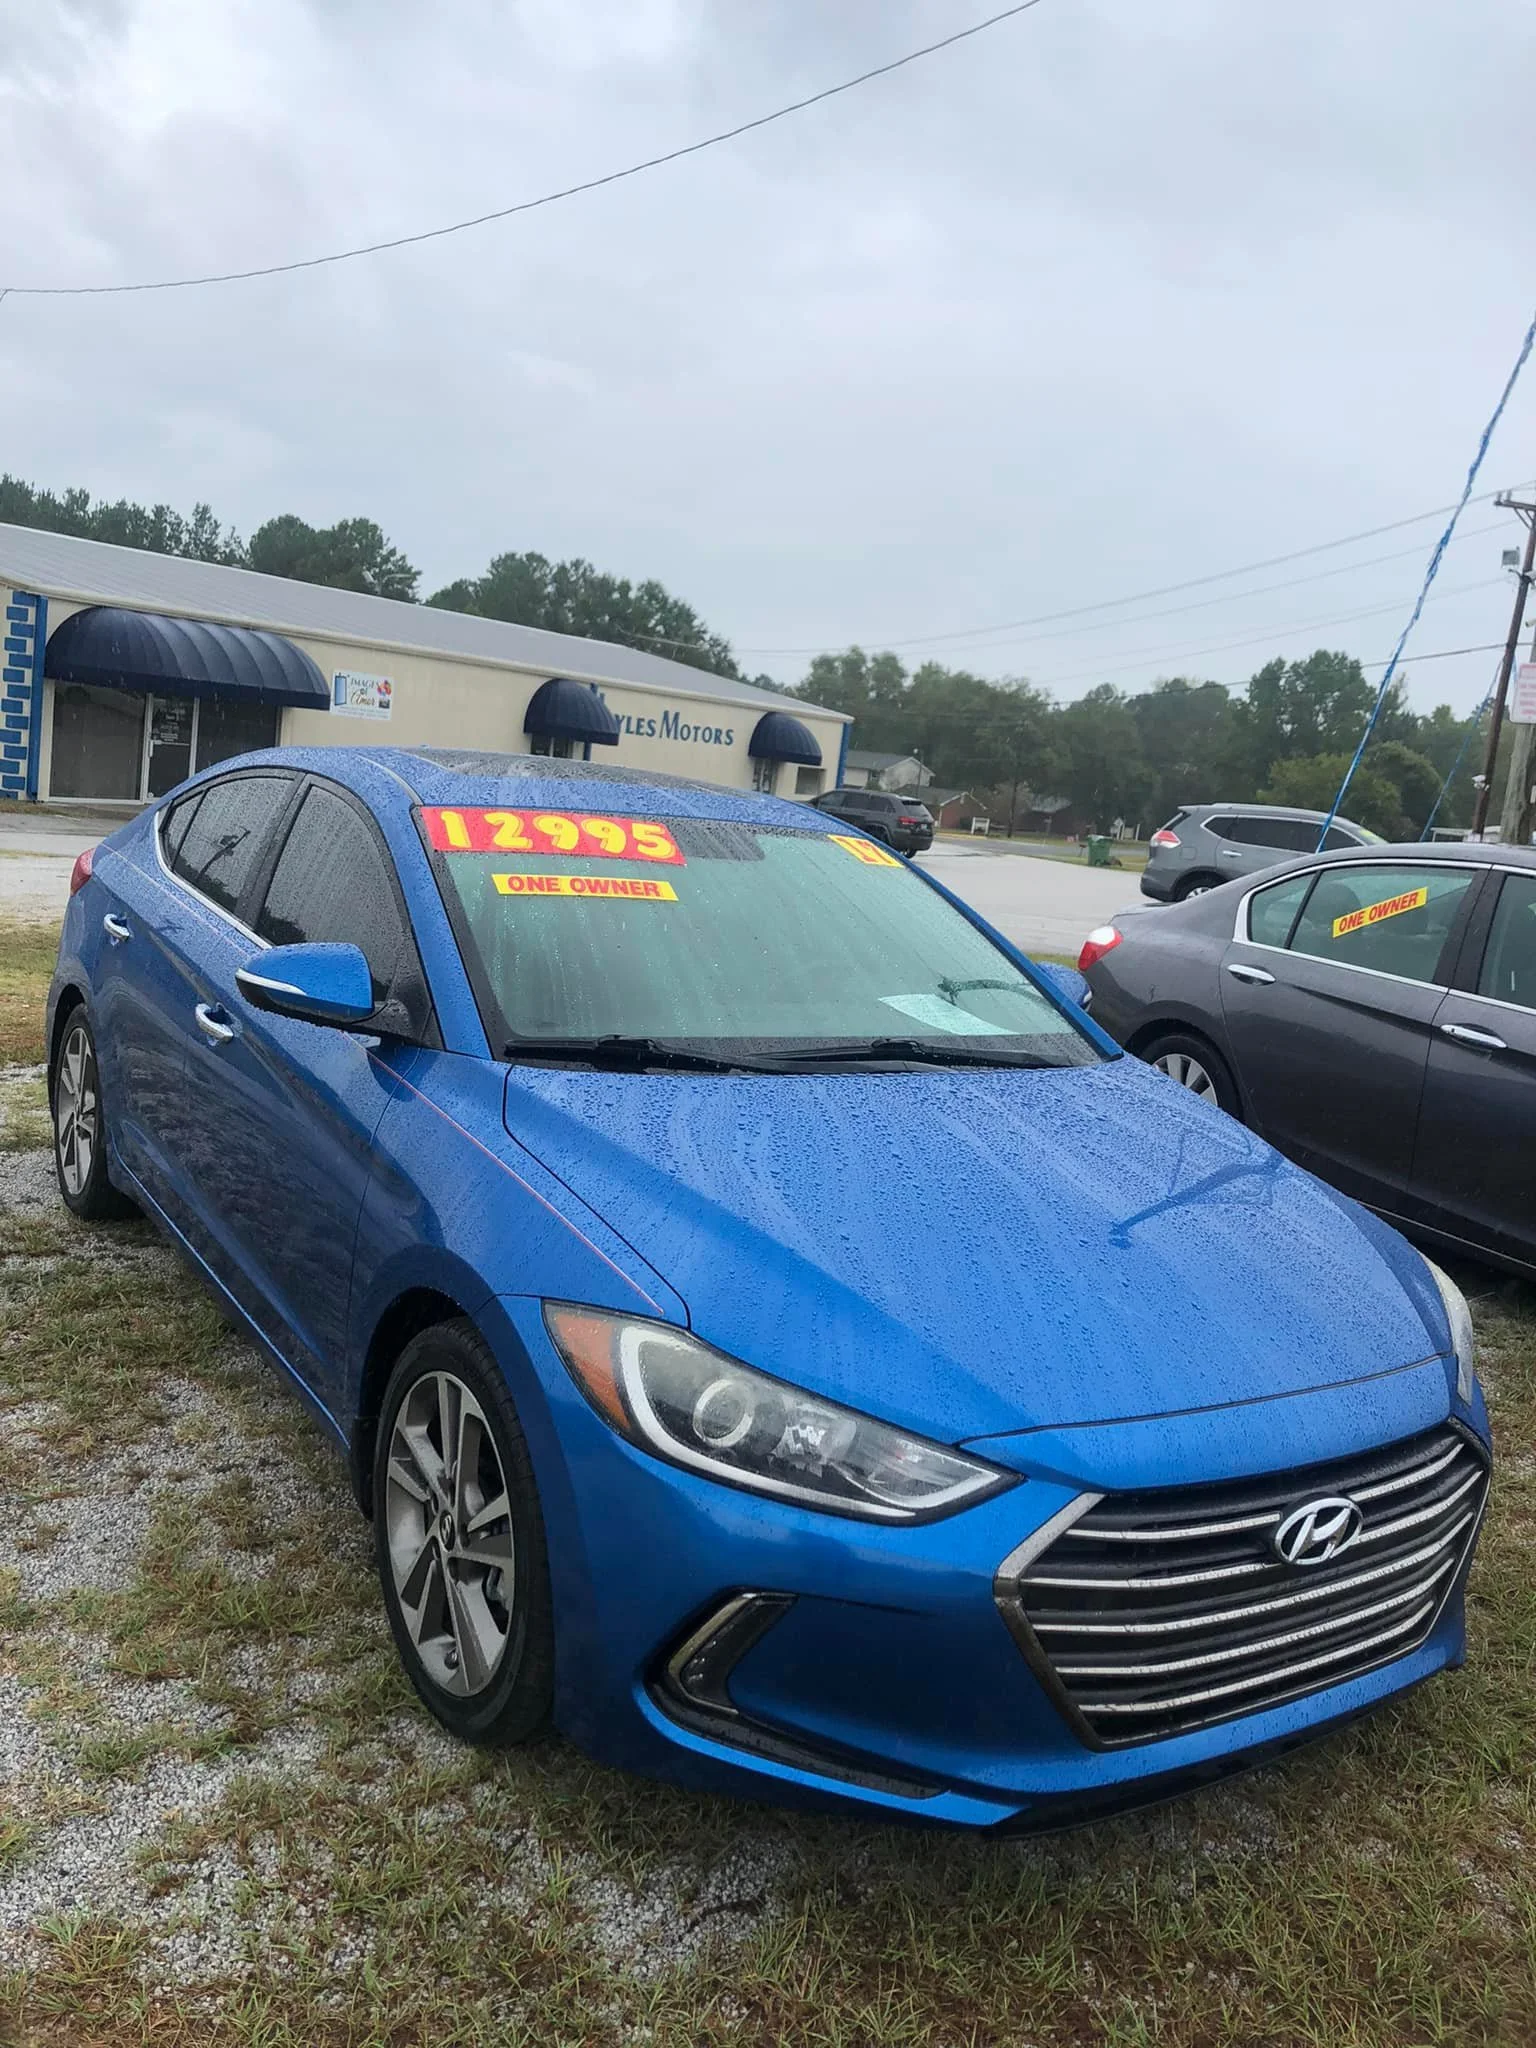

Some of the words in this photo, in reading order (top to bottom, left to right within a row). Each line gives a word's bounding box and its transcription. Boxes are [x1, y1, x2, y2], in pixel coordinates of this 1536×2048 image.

[612, 711, 657, 738] YLES
[440, 810, 676, 859] 12995
[507, 875, 561, 893] ONE
[569, 876, 661, 898] OWNER
[1338, 910, 1365, 933] ONE
[1368, 891, 1419, 921] OWNER
